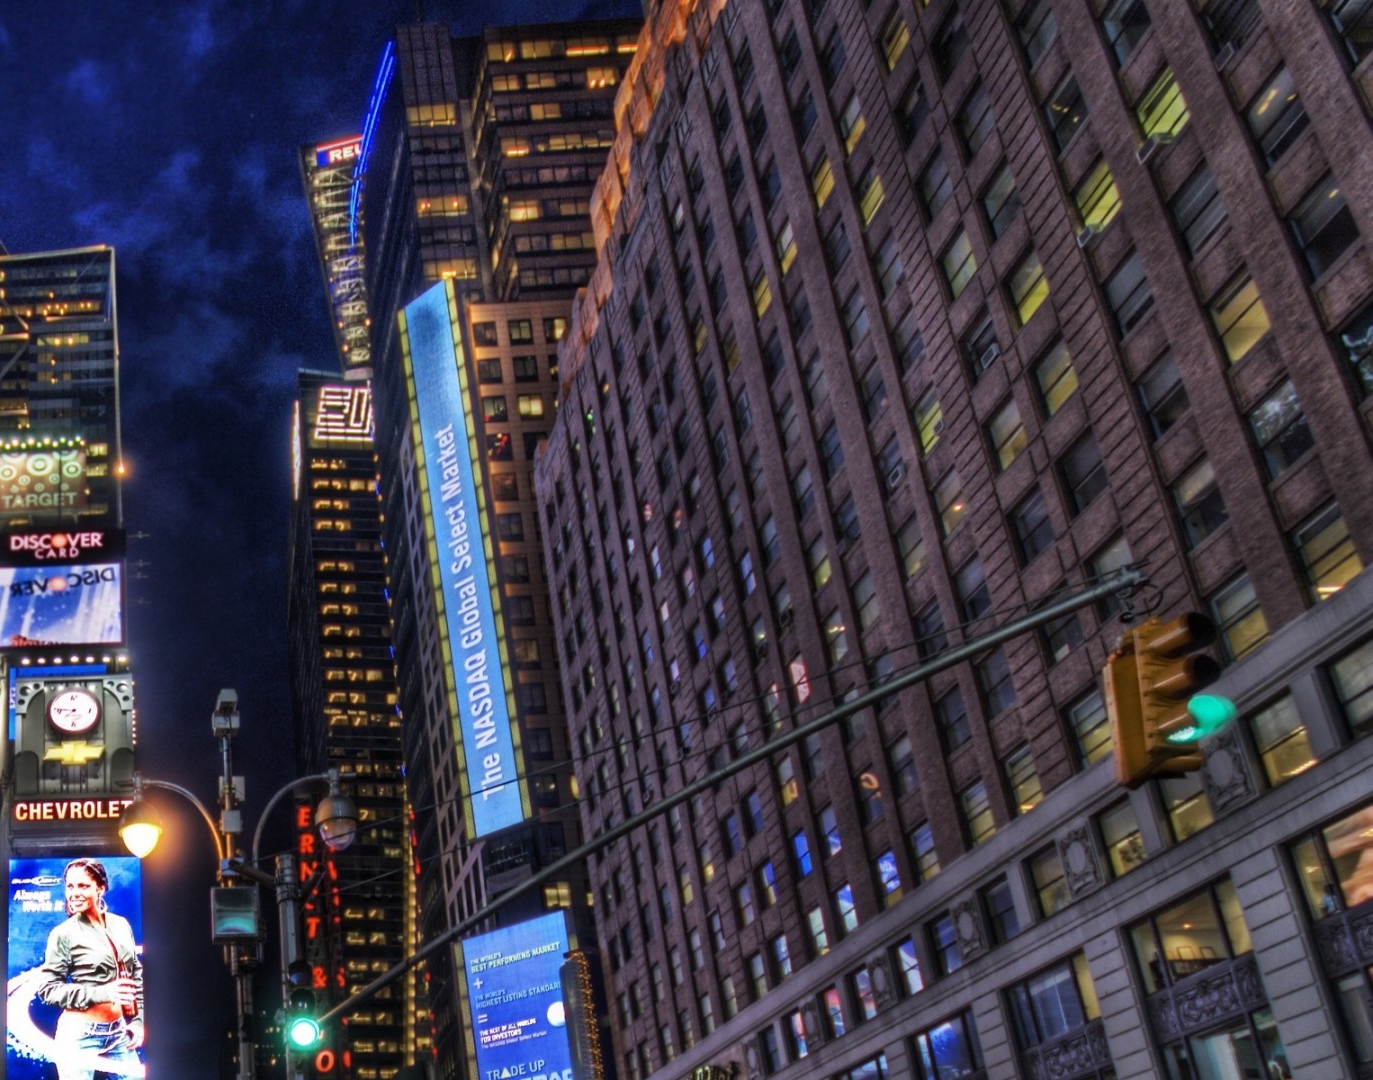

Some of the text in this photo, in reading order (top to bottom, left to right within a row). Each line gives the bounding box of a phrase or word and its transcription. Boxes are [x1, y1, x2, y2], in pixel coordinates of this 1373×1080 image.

[1, 491, 78, 509] TARGET
[10, 532, 103, 550] DISCOVER
[35, 548, 80, 559] CARD
[435, 422, 505, 801] The NASDAQ Global Select Market
[531, 941, 561, 956] MARKET
[529, 1059, 546, 1073] UP
